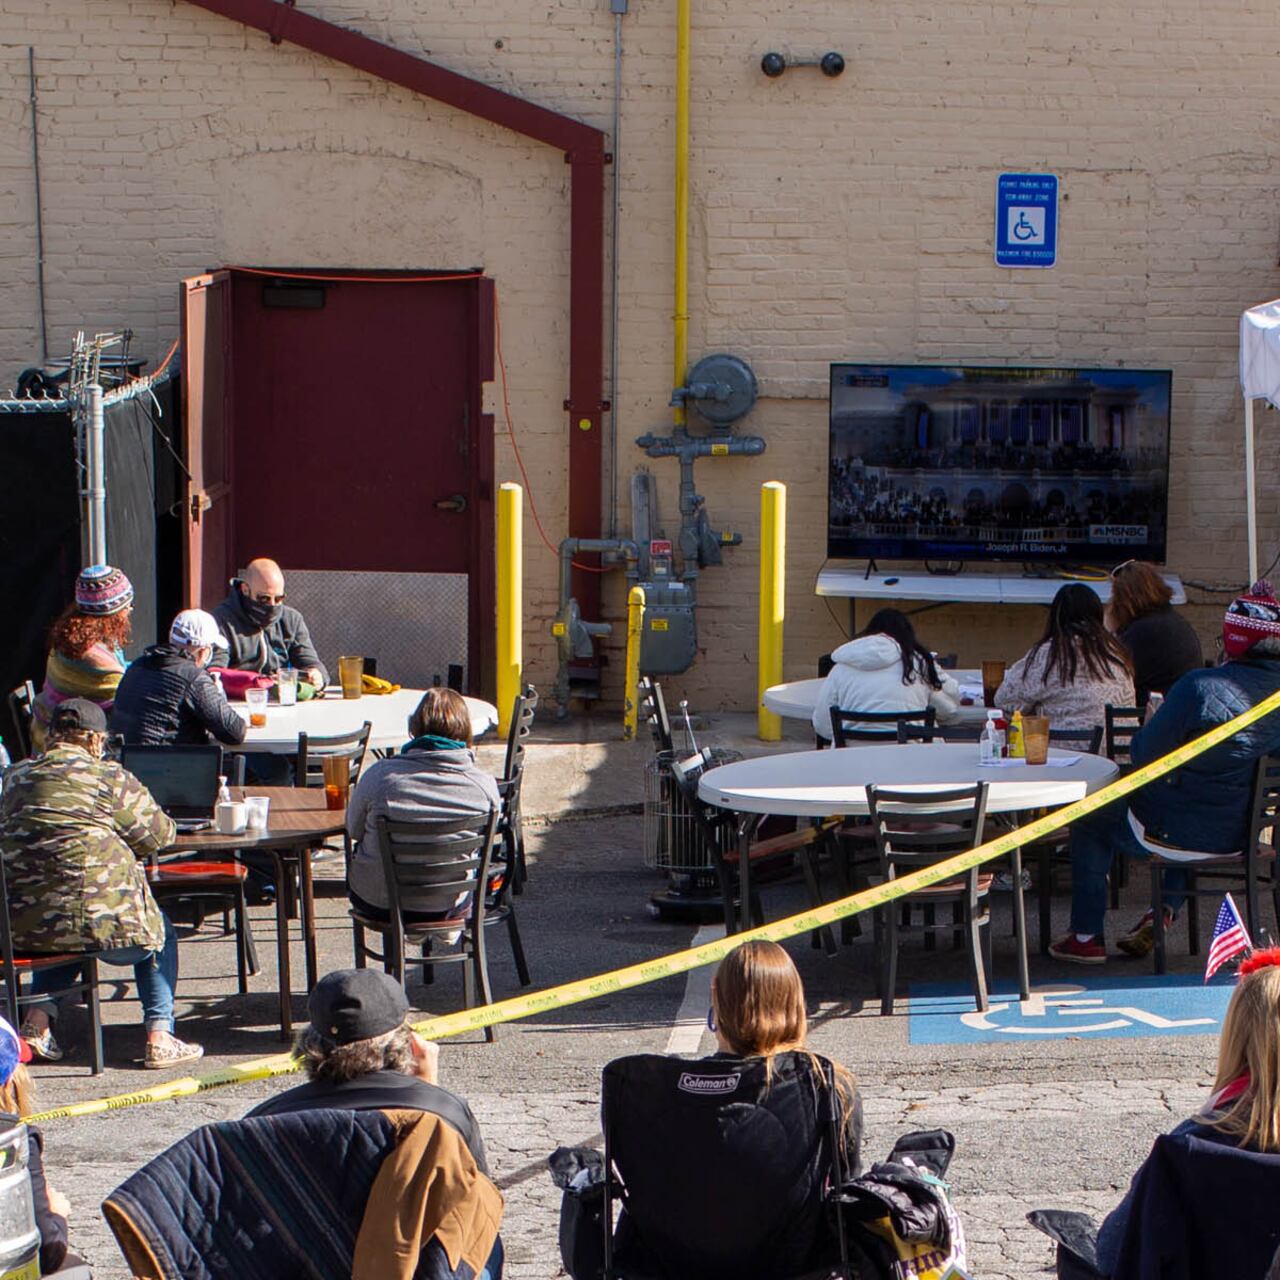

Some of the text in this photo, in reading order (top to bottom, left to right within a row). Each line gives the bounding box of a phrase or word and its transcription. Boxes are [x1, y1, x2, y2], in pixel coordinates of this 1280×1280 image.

[1105, 526, 1145, 537] MSNBC
[985, 541, 1018, 552] Joseph
[683, 1075, 726, 1088] Coleman
